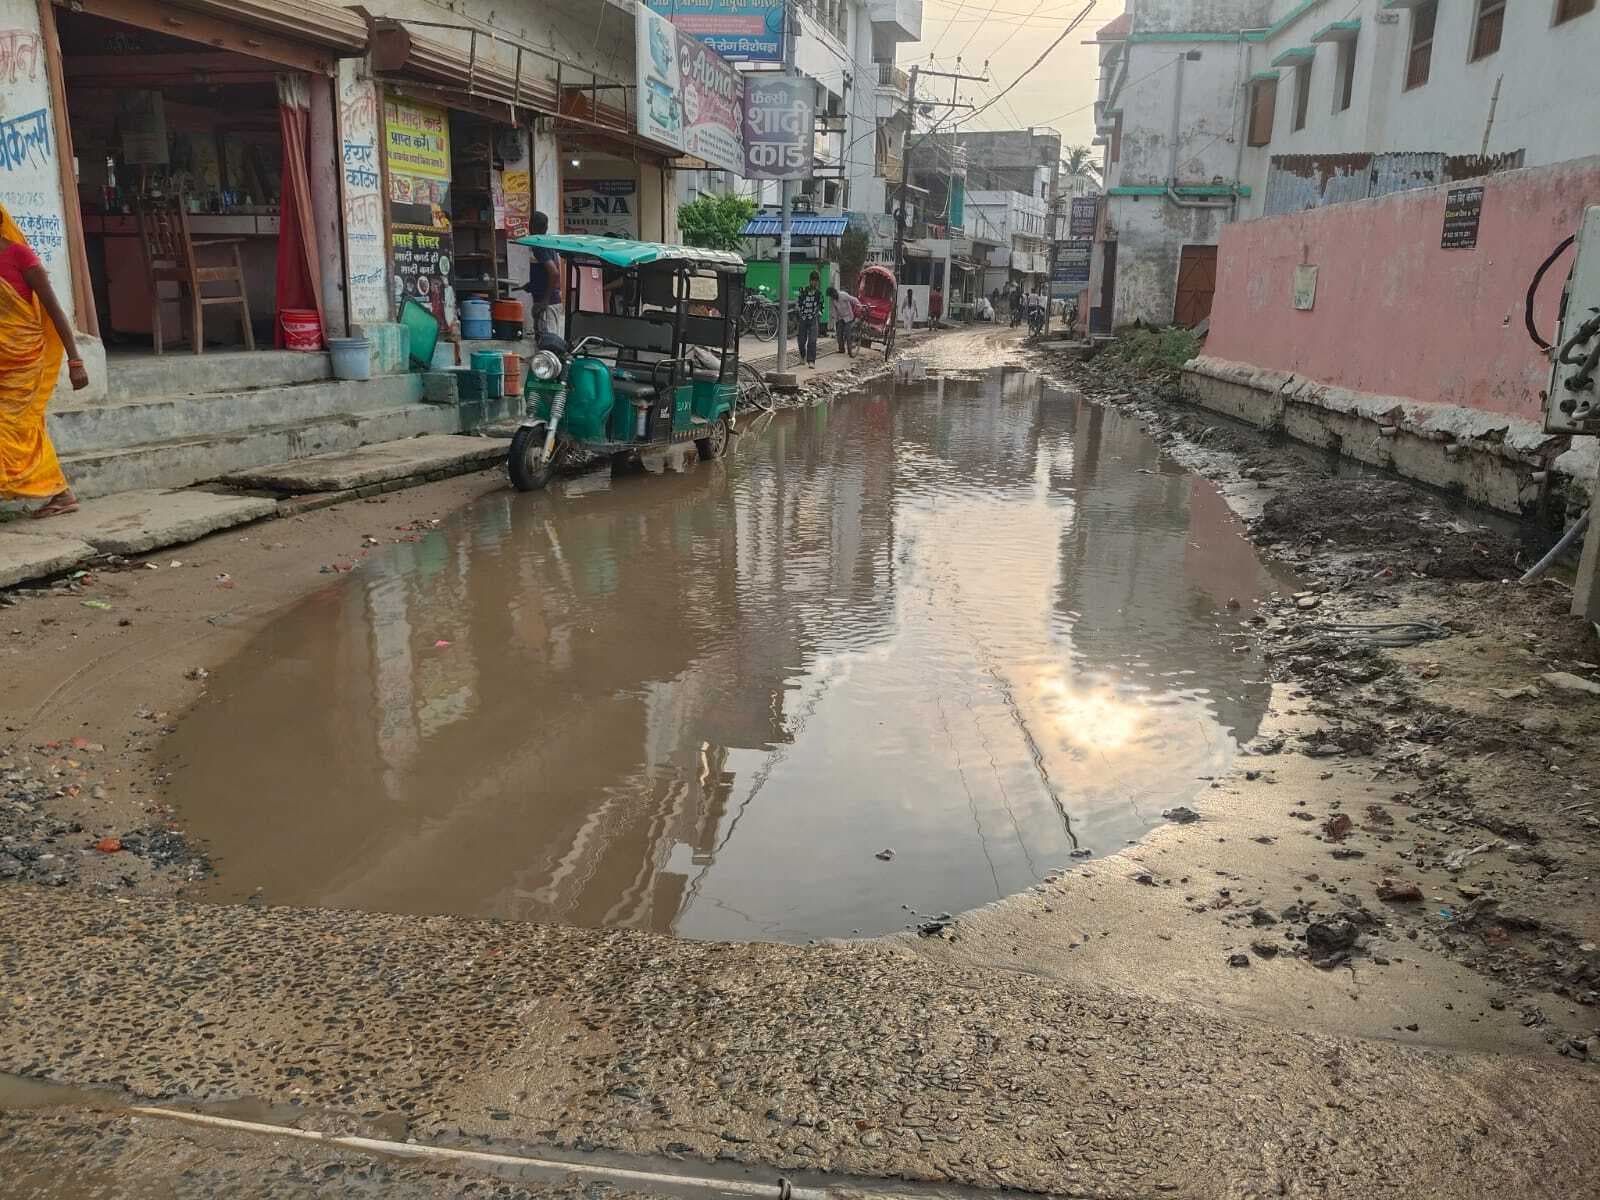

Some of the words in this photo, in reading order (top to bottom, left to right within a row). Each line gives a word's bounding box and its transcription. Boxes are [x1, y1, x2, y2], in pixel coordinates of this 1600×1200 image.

[748, 100, 811, 136] शादी
[749, 135, 808, 167] कार्ड
[881, 249, 895, 262] INN
